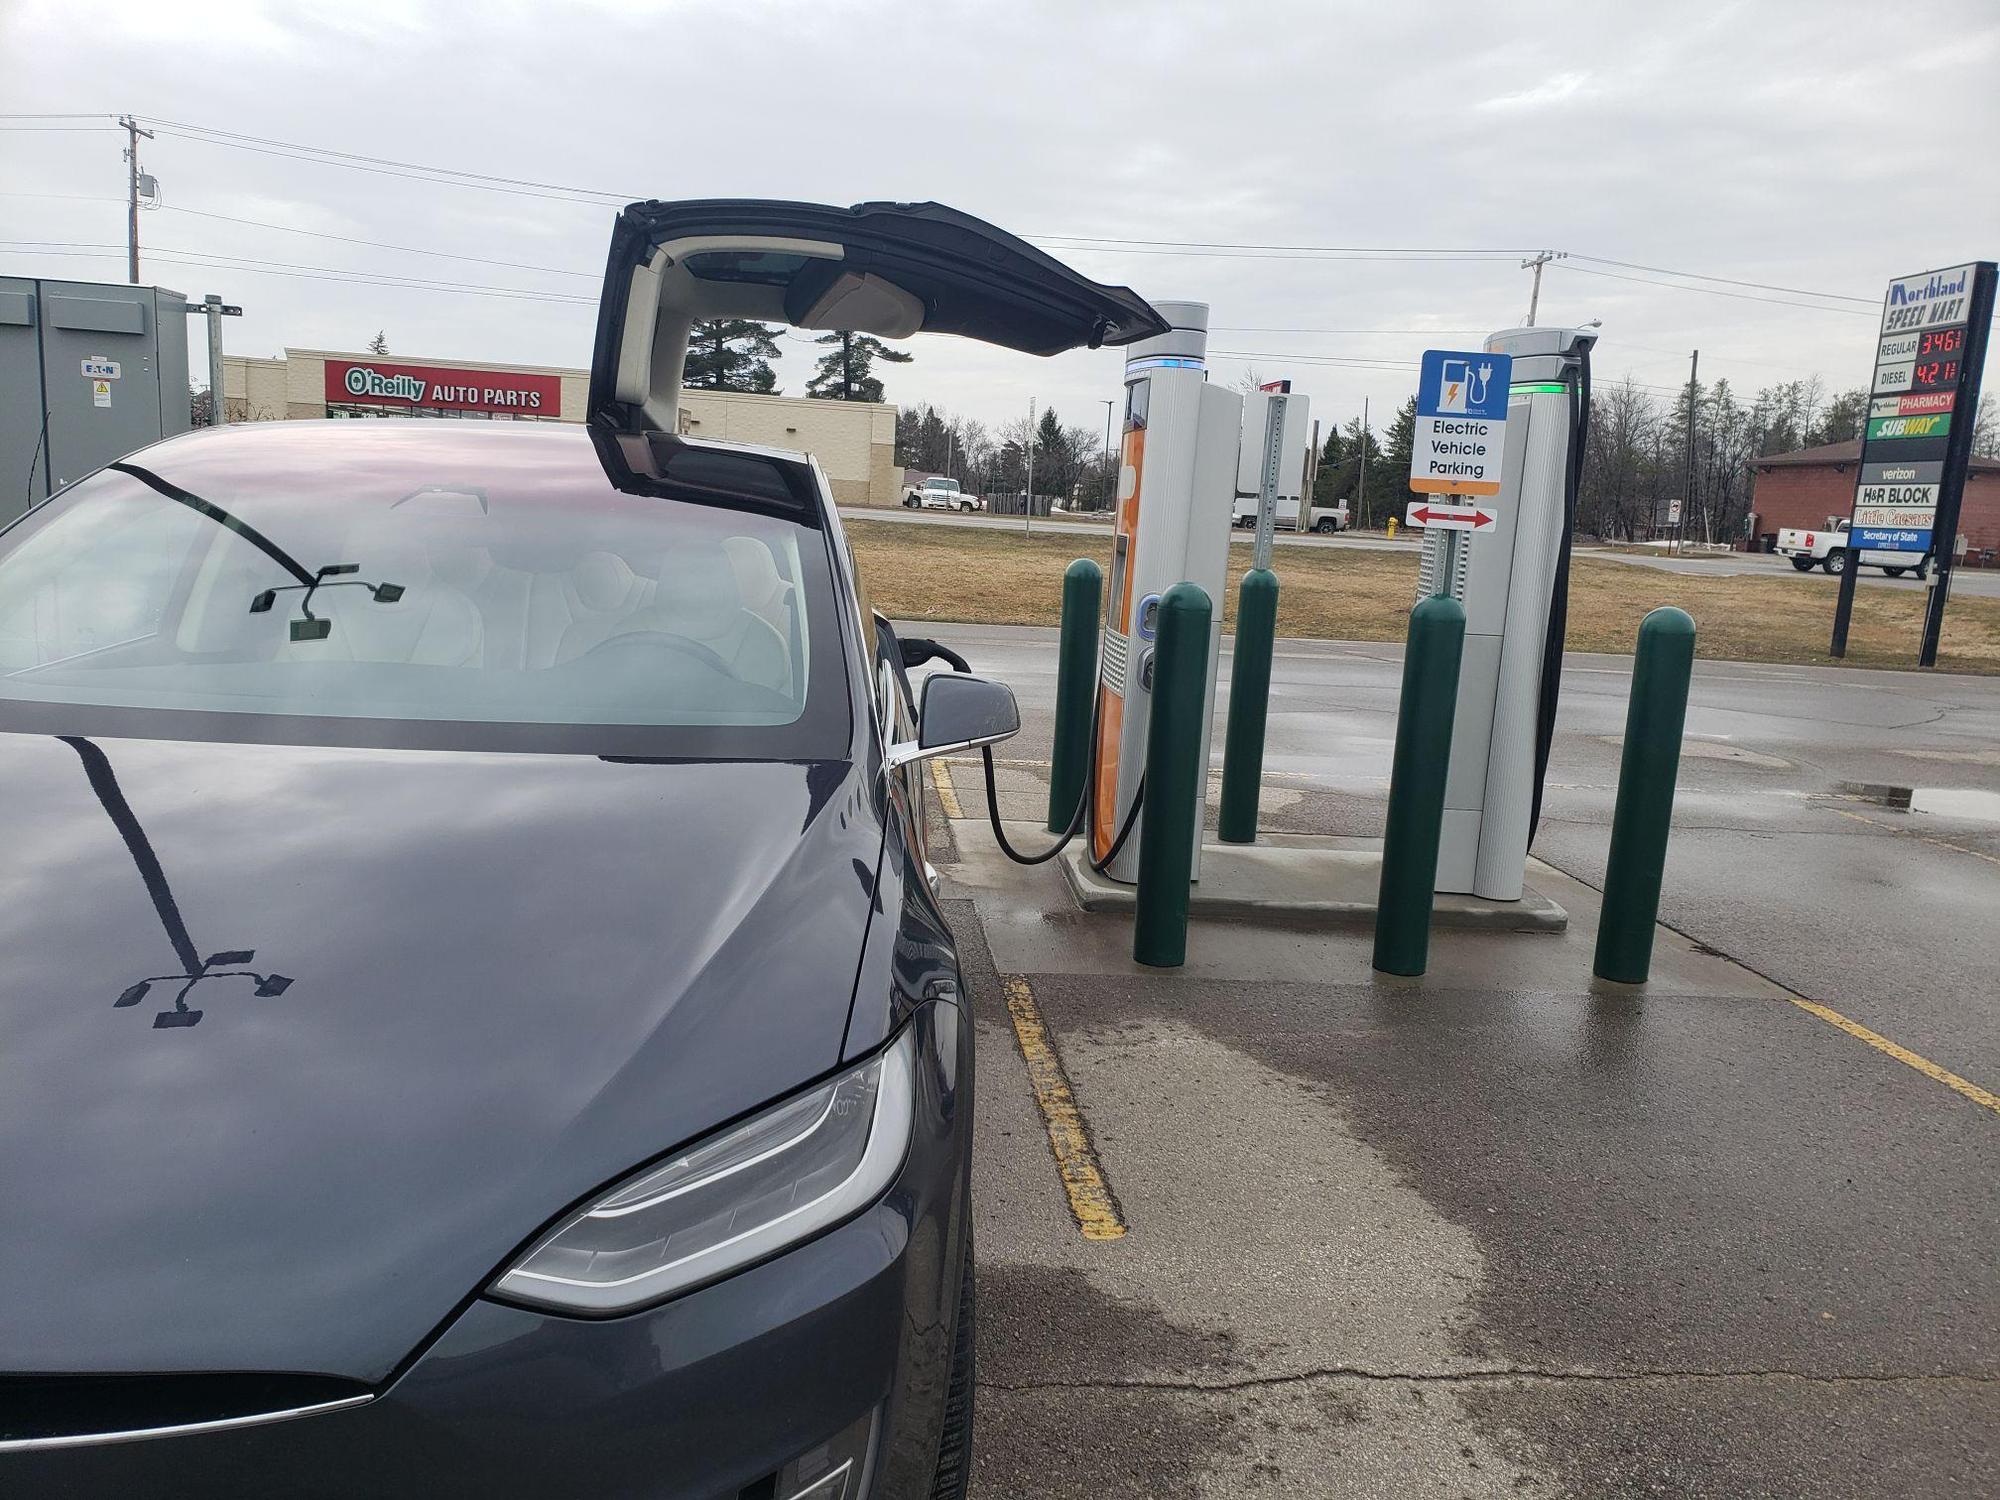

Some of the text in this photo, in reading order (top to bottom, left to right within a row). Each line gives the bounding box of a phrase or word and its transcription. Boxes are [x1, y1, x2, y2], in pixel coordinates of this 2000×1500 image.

[1886, 298, 1965, 331] SPEED MART
[1881, 340, 1917, 357] REGULAR
[1881, 371, 1907, 385] DIESEL
[346, 367, 541, 408] O'Reilly AUTO PARTS
[1900, 395, 1953, 410] PHARMACY
[1432, 420, 1489, 436] Electric
[1877, 417, 1940, 437] SUBWAY
[1431, 440, 1486, 456] Vehicle
[1429, 460, 1484, 479] Parking
[1882, 468, 1916, 480] verizon
[1863, 487, 1930, 503] H&R BLOCK
[1855, 509, 1933, 527] Little Caesars
[1862, 530, 1918, 542] Secretary of State
